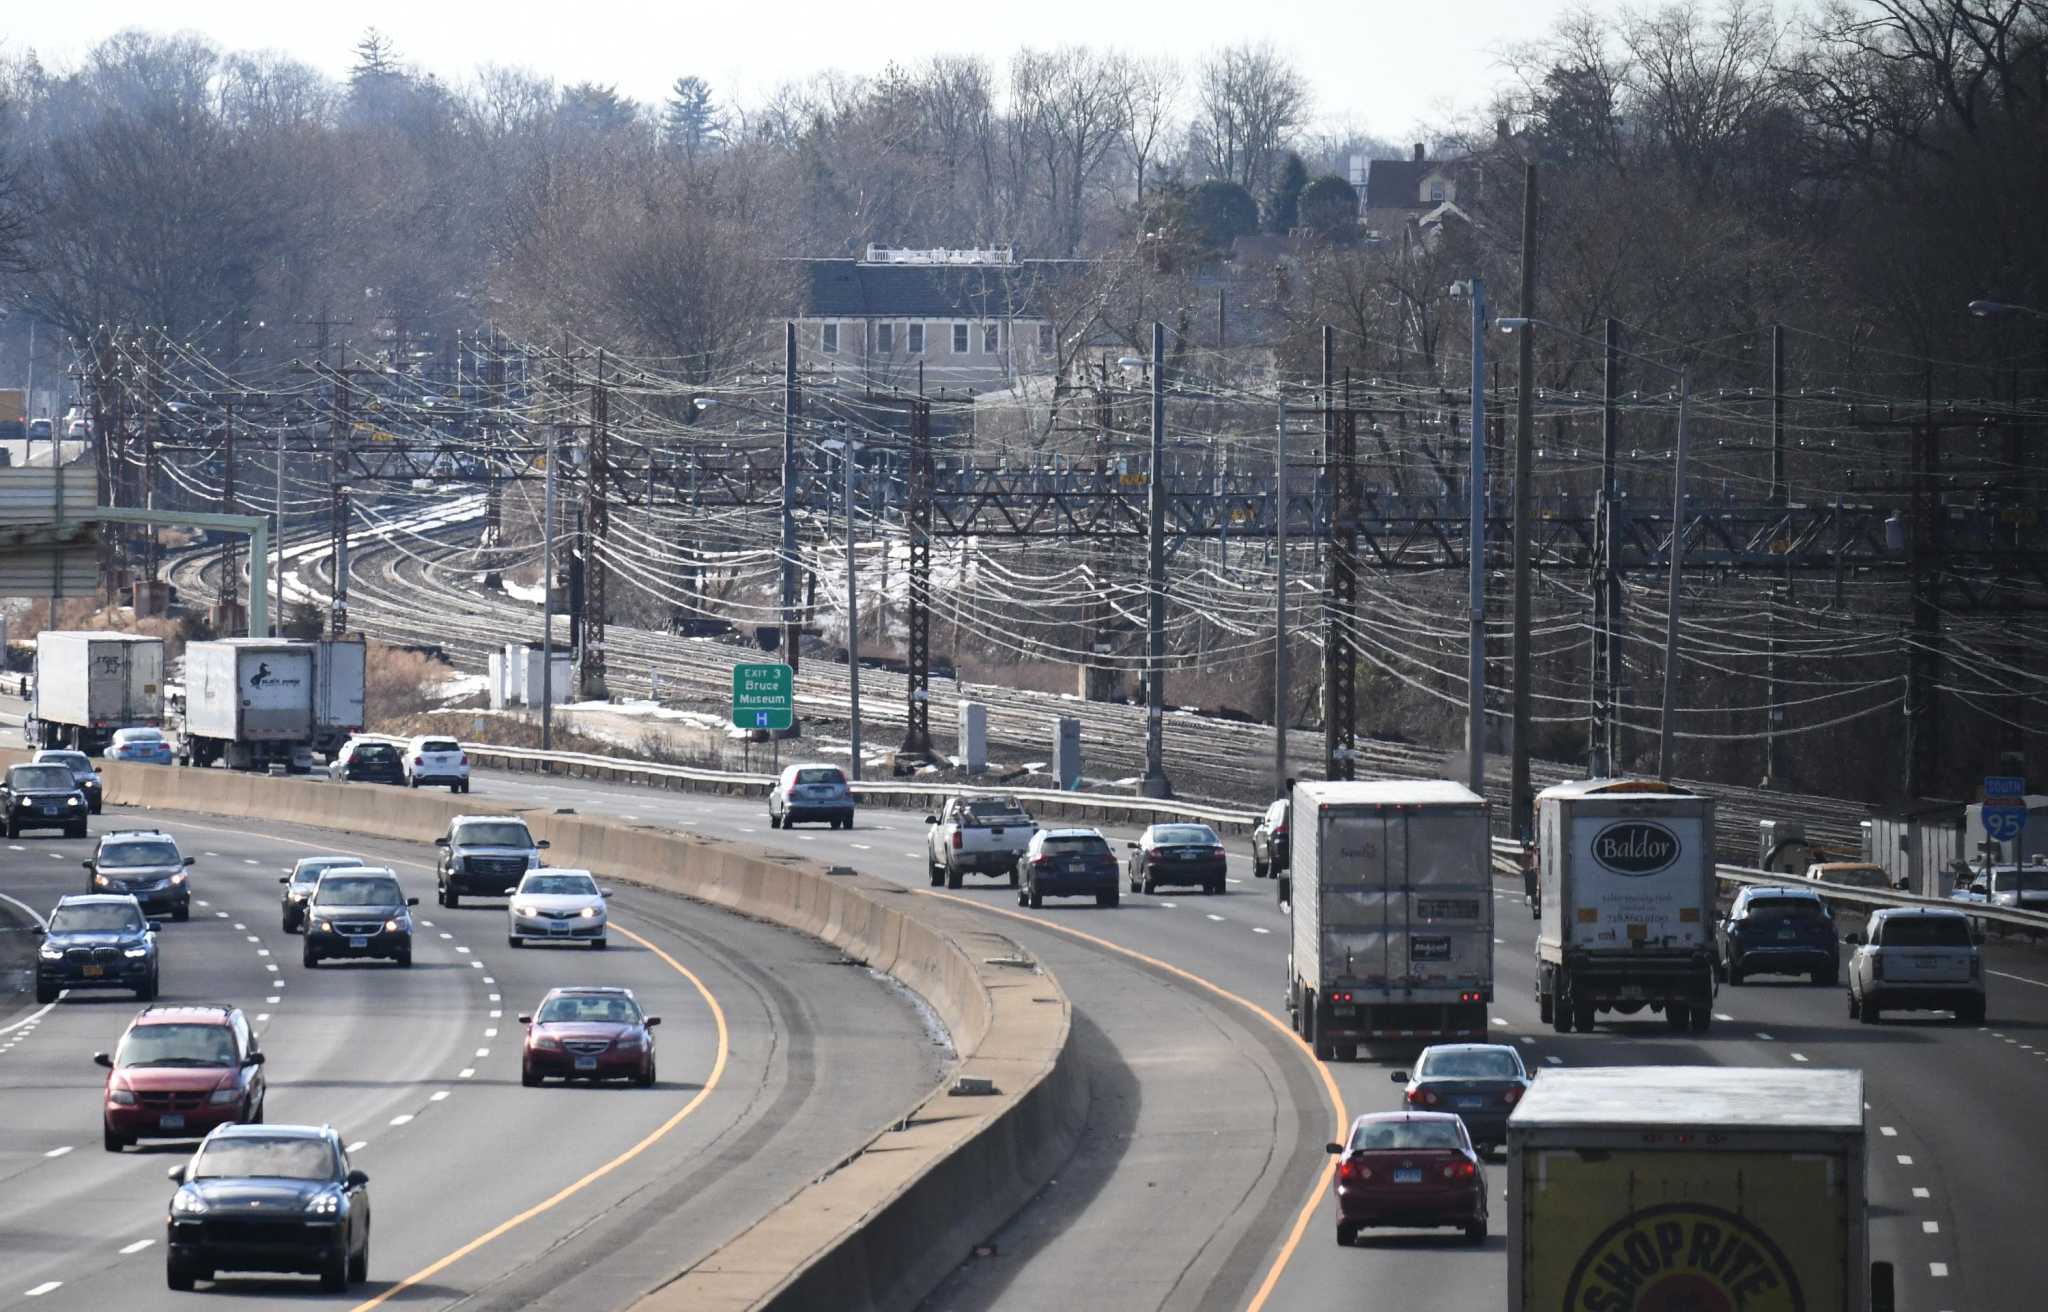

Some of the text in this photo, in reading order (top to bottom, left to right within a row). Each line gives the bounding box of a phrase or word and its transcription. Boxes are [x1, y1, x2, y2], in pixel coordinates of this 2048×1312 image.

[744, 669, 781, 679] EXIT 3
[745, 680, 779, 691] Bruce
[740, 694, 785, 704] Museum
[756, 712, 767, 726] H
[1988, 814, 2019, 836] 95
[1602, 829, 1670, 858] Baldor
